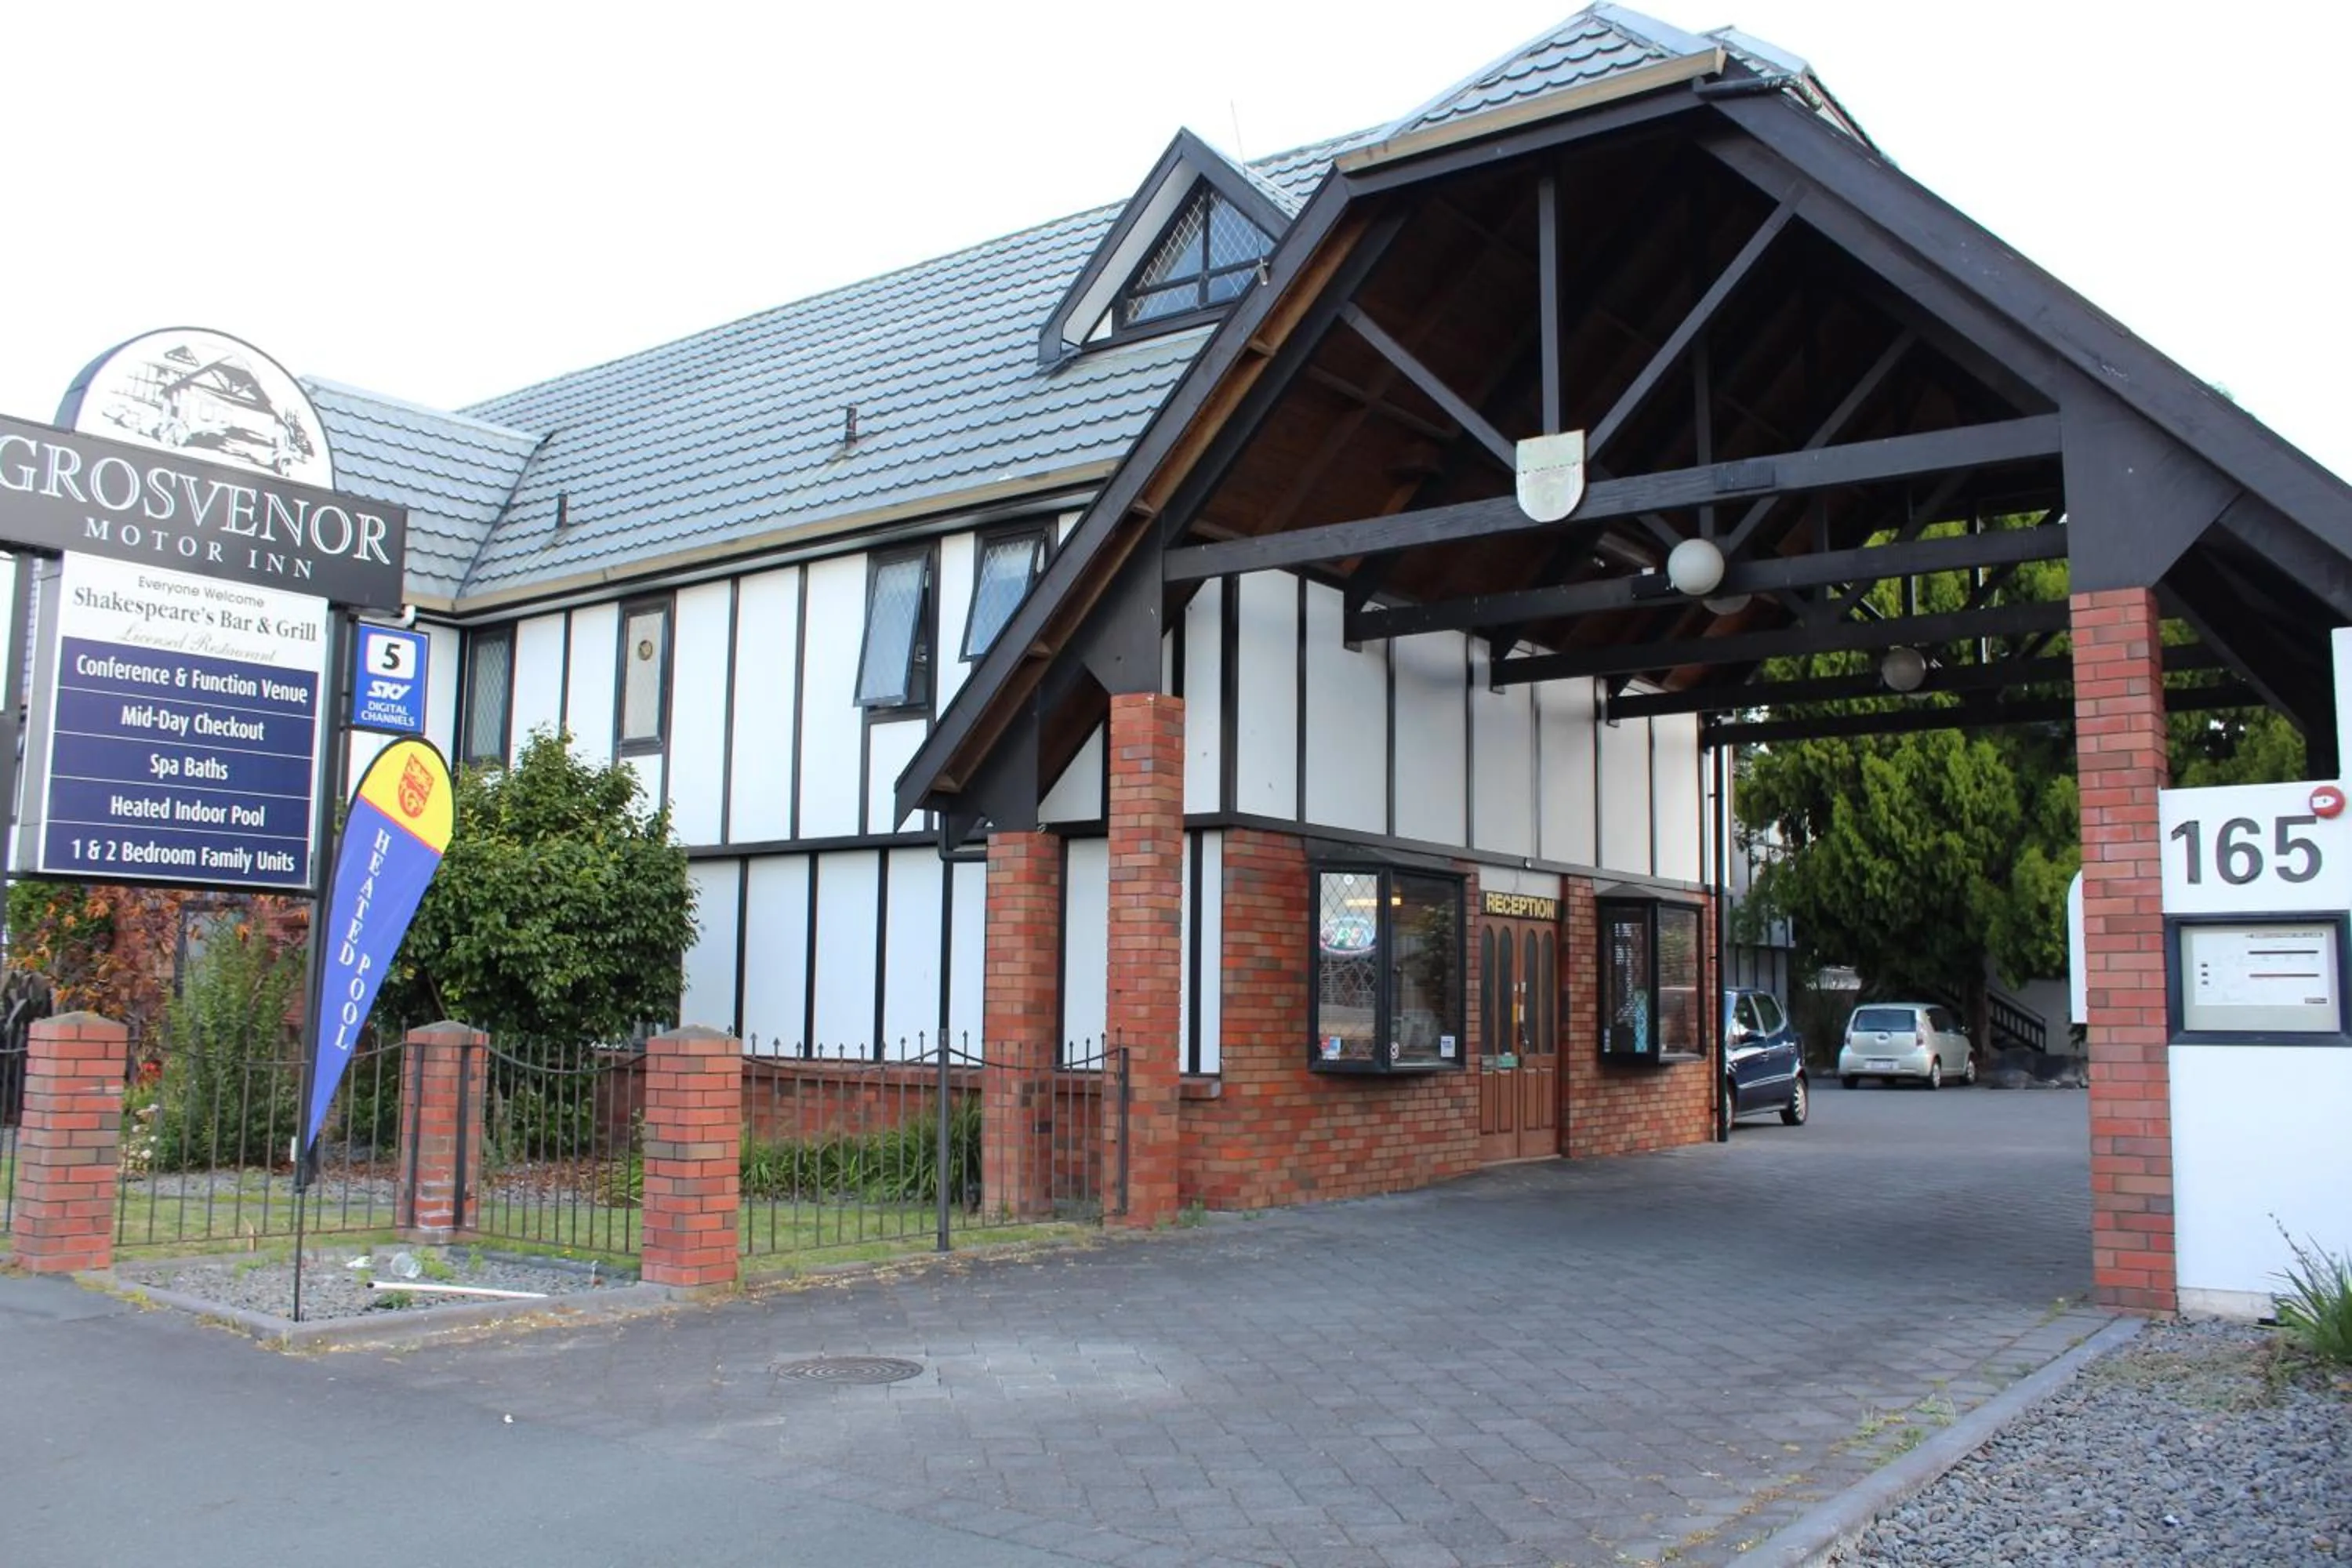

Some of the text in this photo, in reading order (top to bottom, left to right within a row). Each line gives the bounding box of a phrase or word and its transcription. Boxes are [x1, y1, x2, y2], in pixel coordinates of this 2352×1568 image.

[0, 435, 391, 565] GROSVENOR
[84, 516, 313, 580] MOTOR INN
[138, 575, 266, 608] Everyone Welcome
[73, 586, 318, 642] Shakespeare's Bar & Grill
[118, 626, 276, 663] Licensed Restaurant
[381, 642, 401, 670] 5
[76, 654, 309, 704] Conference & Function Venue
[367, 680, 412, 701] SKY
[121, 705, 265, 741] Mid-Day Checkout
[361, 710, 415, 728] CHANNELS
[368, 700, 408, 716] DIGITAL
[150, 753, 229, 780] Spa Baths
[111, 795, 265, 827] Heated Indoor Pool
[72, 838, 295, 874] 1 & 2 Bedroom Family Units
[2170, 815, 2323, 885] 165
[339, 827, 391, 967] HEATED
[1486, 892, 1556, 920] RECEPTION
[335, 953, 371, 1051] POOL
